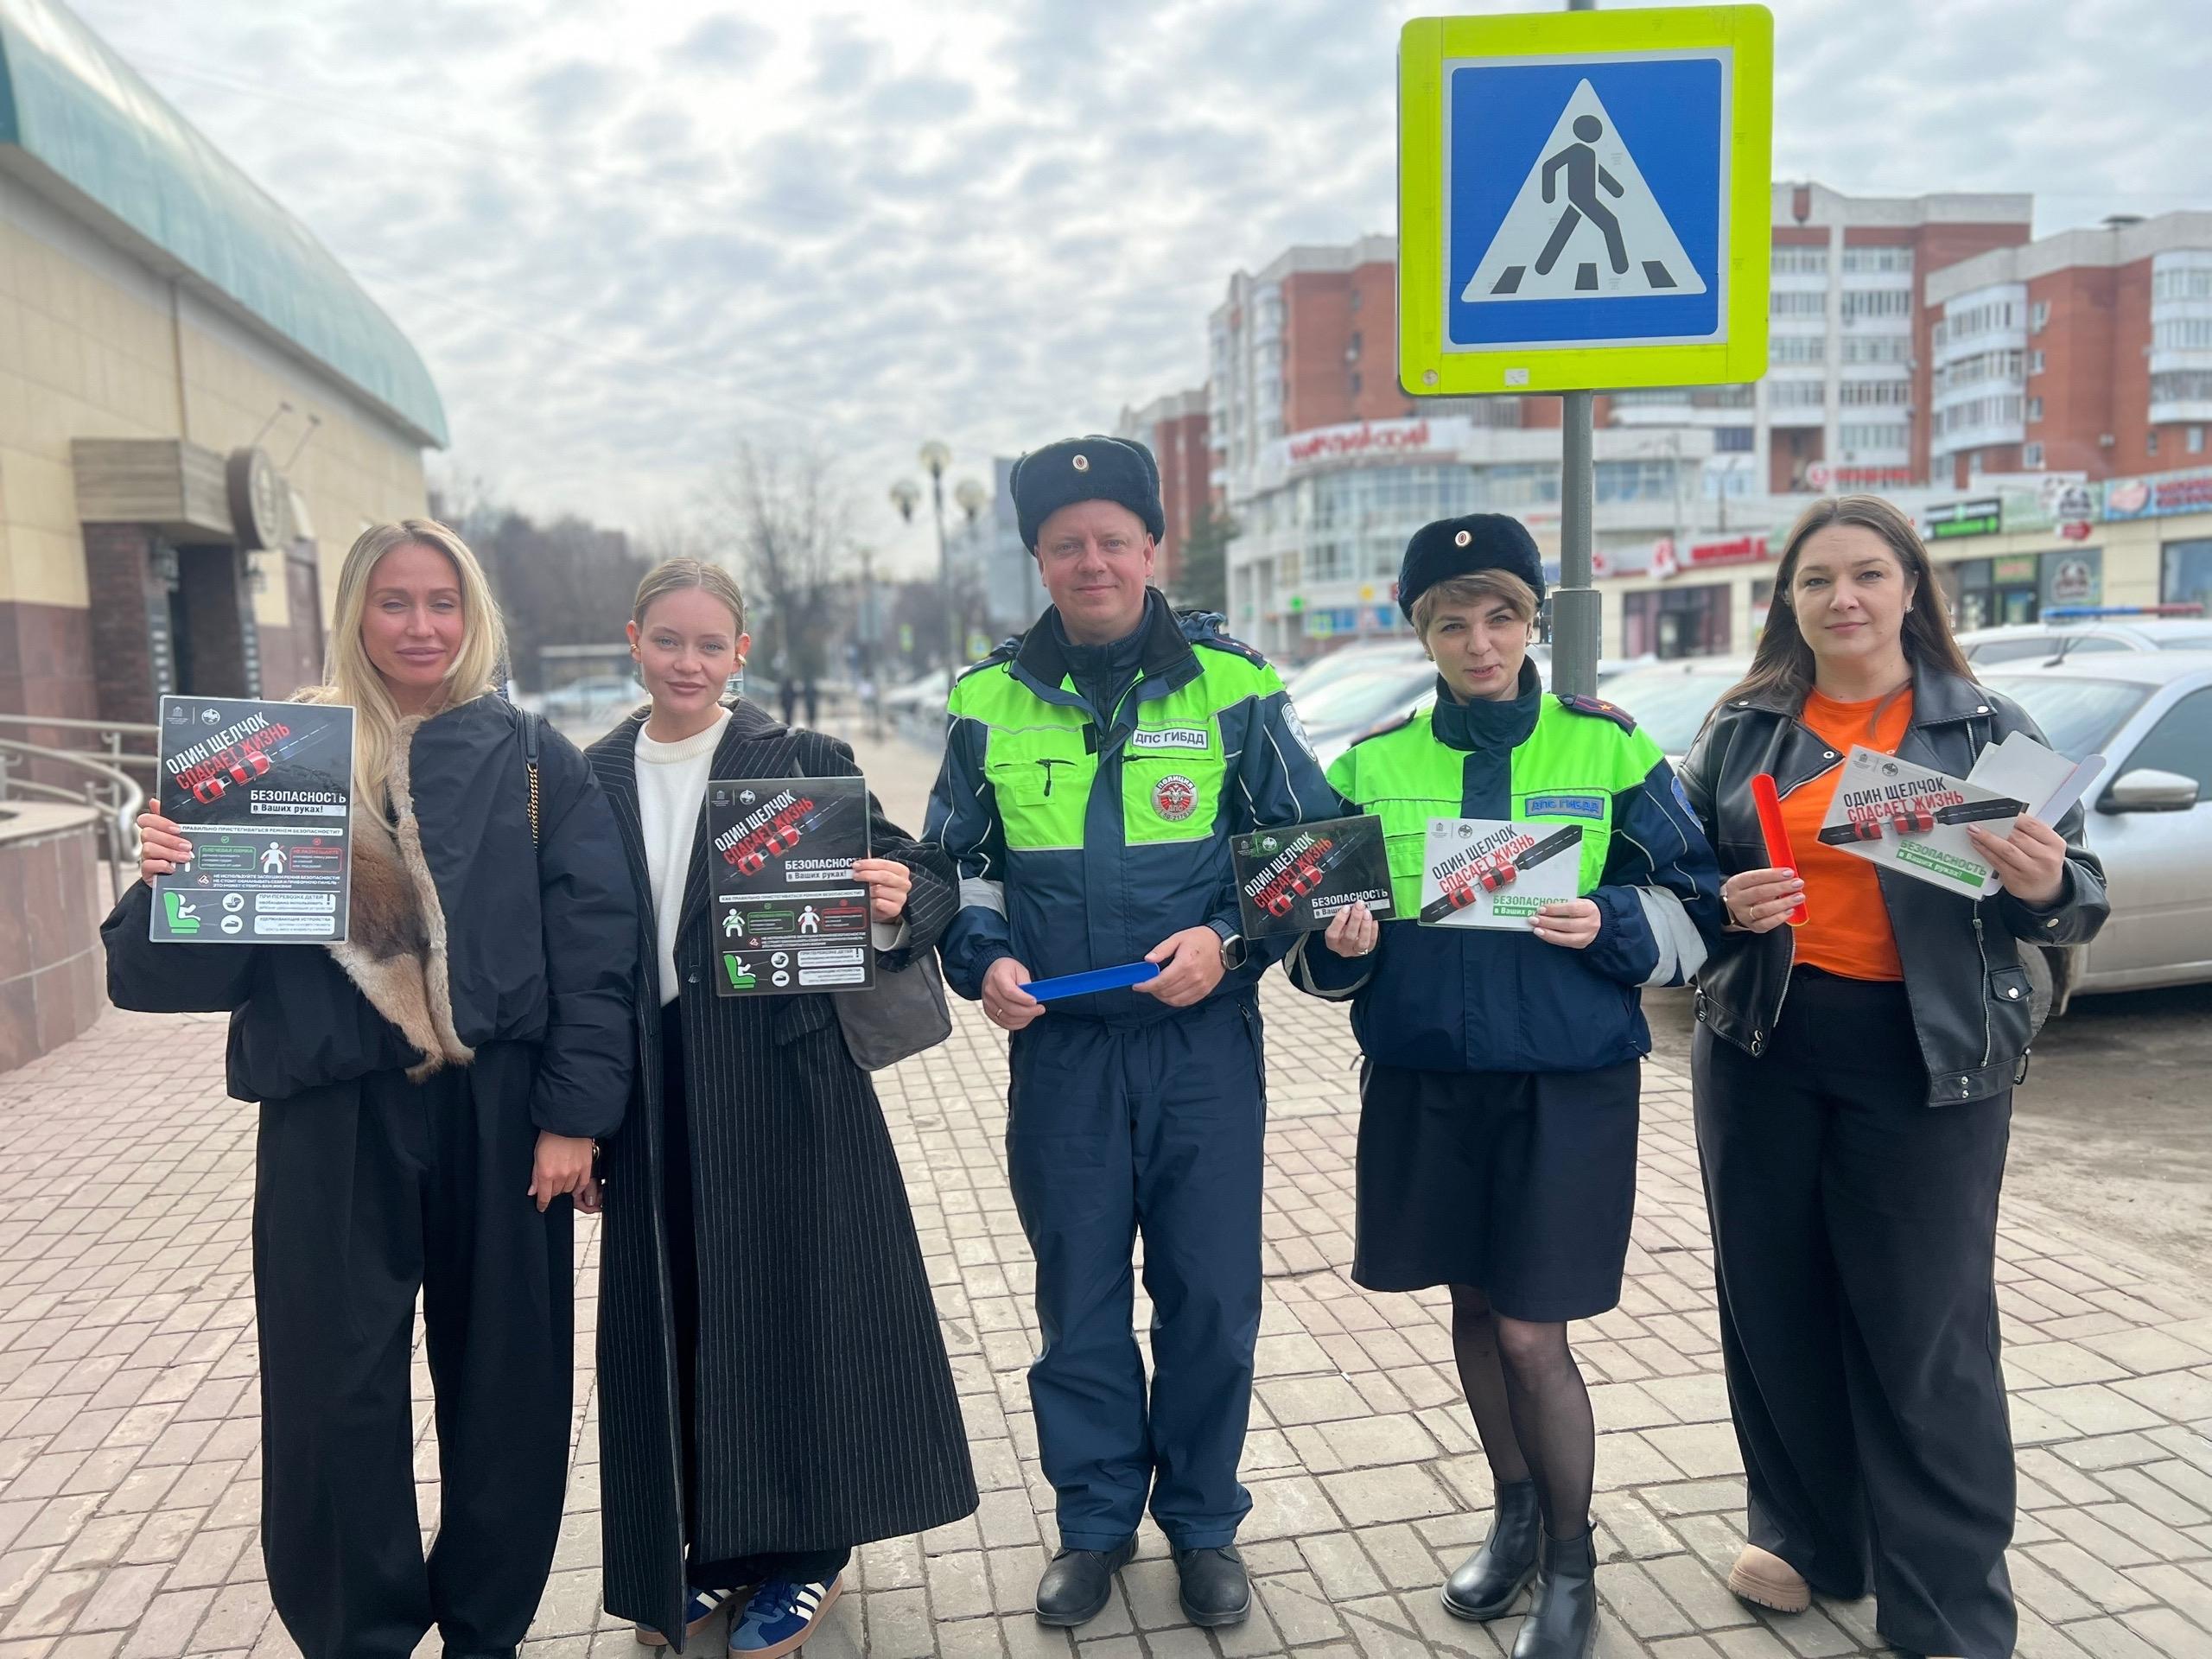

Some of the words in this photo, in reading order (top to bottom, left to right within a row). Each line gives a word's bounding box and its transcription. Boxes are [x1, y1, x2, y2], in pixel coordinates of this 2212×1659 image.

[166, 742, 209, 774] ОДИН
[206, 711, 270, 753] ЩЕЛЧОК
[1135, 734, 1160, 744] ДПС
[1164, 732, 1205, 745] ГИБДД
[175, 747, 239, 790] СПАСАЕТ
[238, 722, 290, 754] ЖИЗНЬ
[251, 790, 346, 803] БЕЗОПАСНОСТЬ
[1157, 775, 1193, 789] ПОЛИЦИЯ
[1843, 787, 1882, 808] ОДИН
[1884, 777, 1947, 800] ЩЕЛЧОК
[261, 804, 291, 812] Ваших
[294, 805, 323, 814] руках!
[714, 821, 750, 851] ОДИН
[745, 789, 797, 830] ЩЕЛЧОК
[1532, 798, 1555, 811] ДПС
[1560, 798, 1599, 813] ГИБДД
[1847, 798, 1908, 823] СПАСАЕТ
[1910, 791, 1964, 810] ЖИЗНЬ
[723, 823, 775, 865] СПАСАЕТ
[773, 797, 814, 830] ЖИЗНЬ
[785, 858, 861, 870] БЕЗОПАСНОС
[1244, 867, 1275, 897] ОДИН
[1269, 831, 1316, 874] ЩЕЛЧОК
[1432, 852, 1466, 880] ОДИН
[1465, 823, 1517, 861] ЩЕЛЧОК
[1439, 856, 1492, 893] СПАСАЕТ
[1491, 834, 1535, 866] ЖИЗНЬ
[1900, 839, 1986, 875] БЕЗОПАСНОСТЬ
[822, 871, 847, 880] руках!
[1254, 865, 1298, 908] СПАСАЕТ
[1294, 837, 1332, 872] ЖИЗНЬ
[1312, 888, 1388, 907] БЕЗОПАСНОСТЬ
